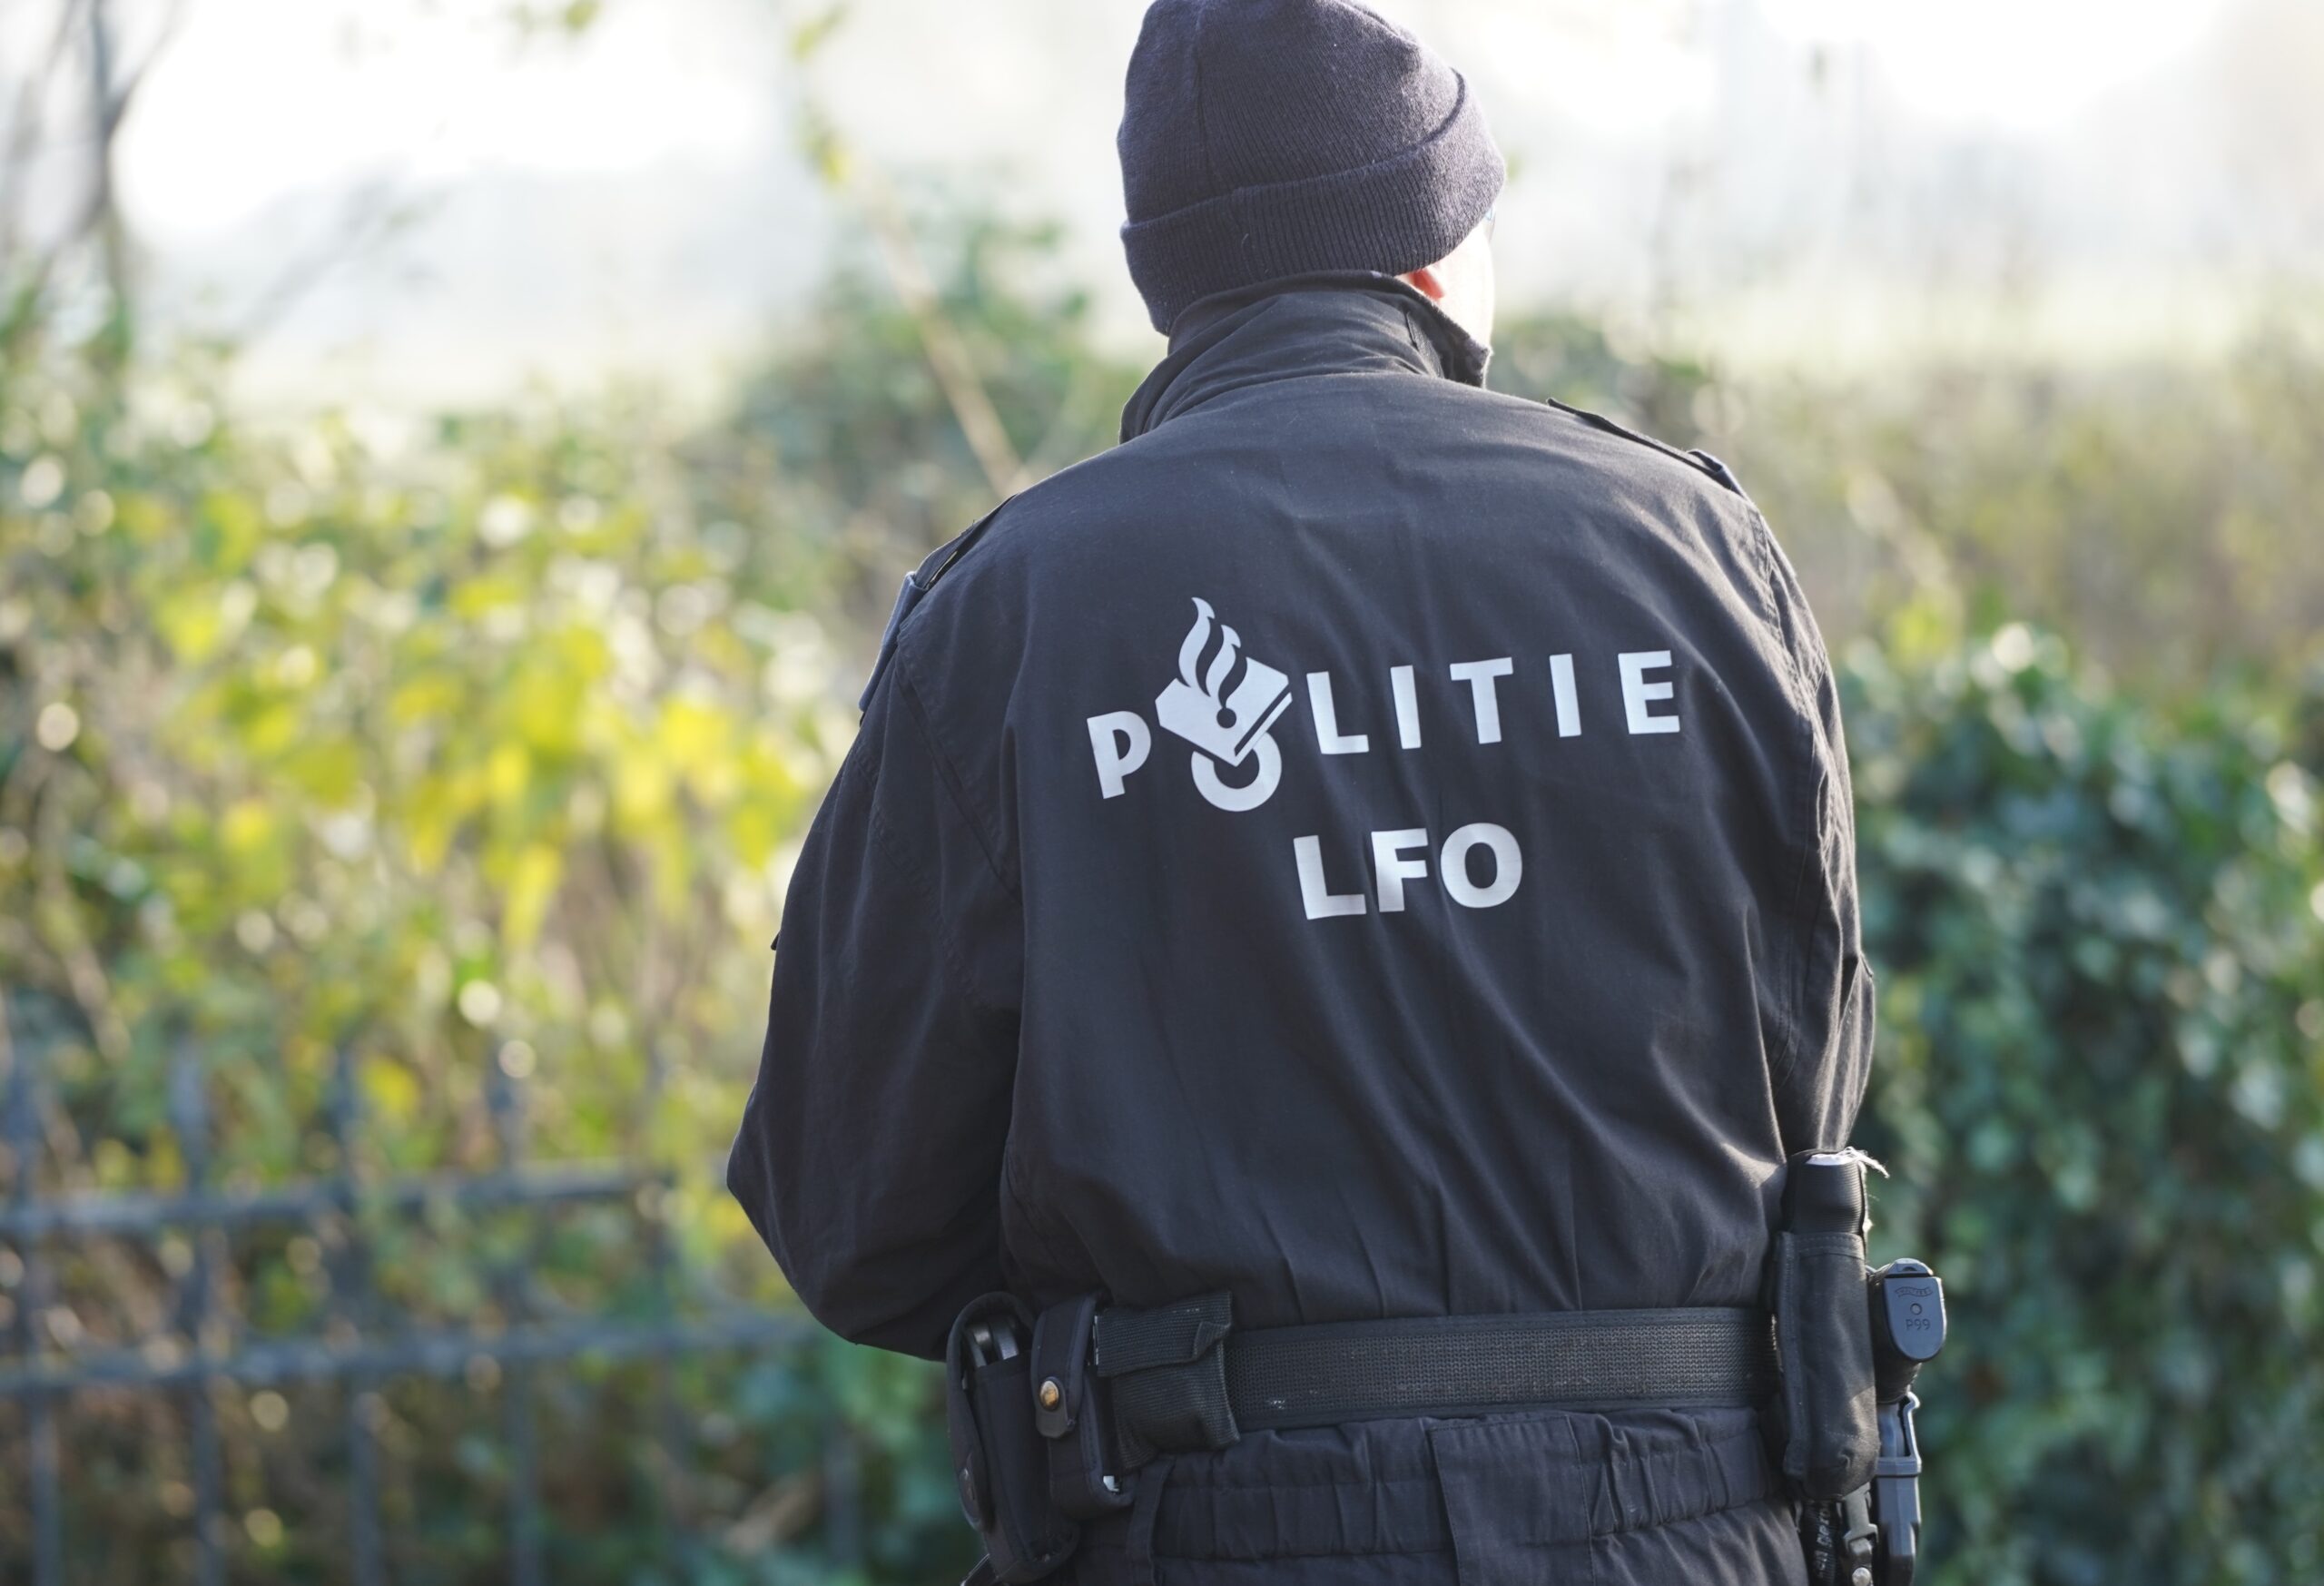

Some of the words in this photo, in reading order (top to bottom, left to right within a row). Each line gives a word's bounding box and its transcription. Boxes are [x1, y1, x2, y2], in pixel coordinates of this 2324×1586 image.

[1086, 650, 1680, 813] POLITIE
[1293, 823, 1523, 921] LFO
[1905, 1318, 1931, 1331] P99
